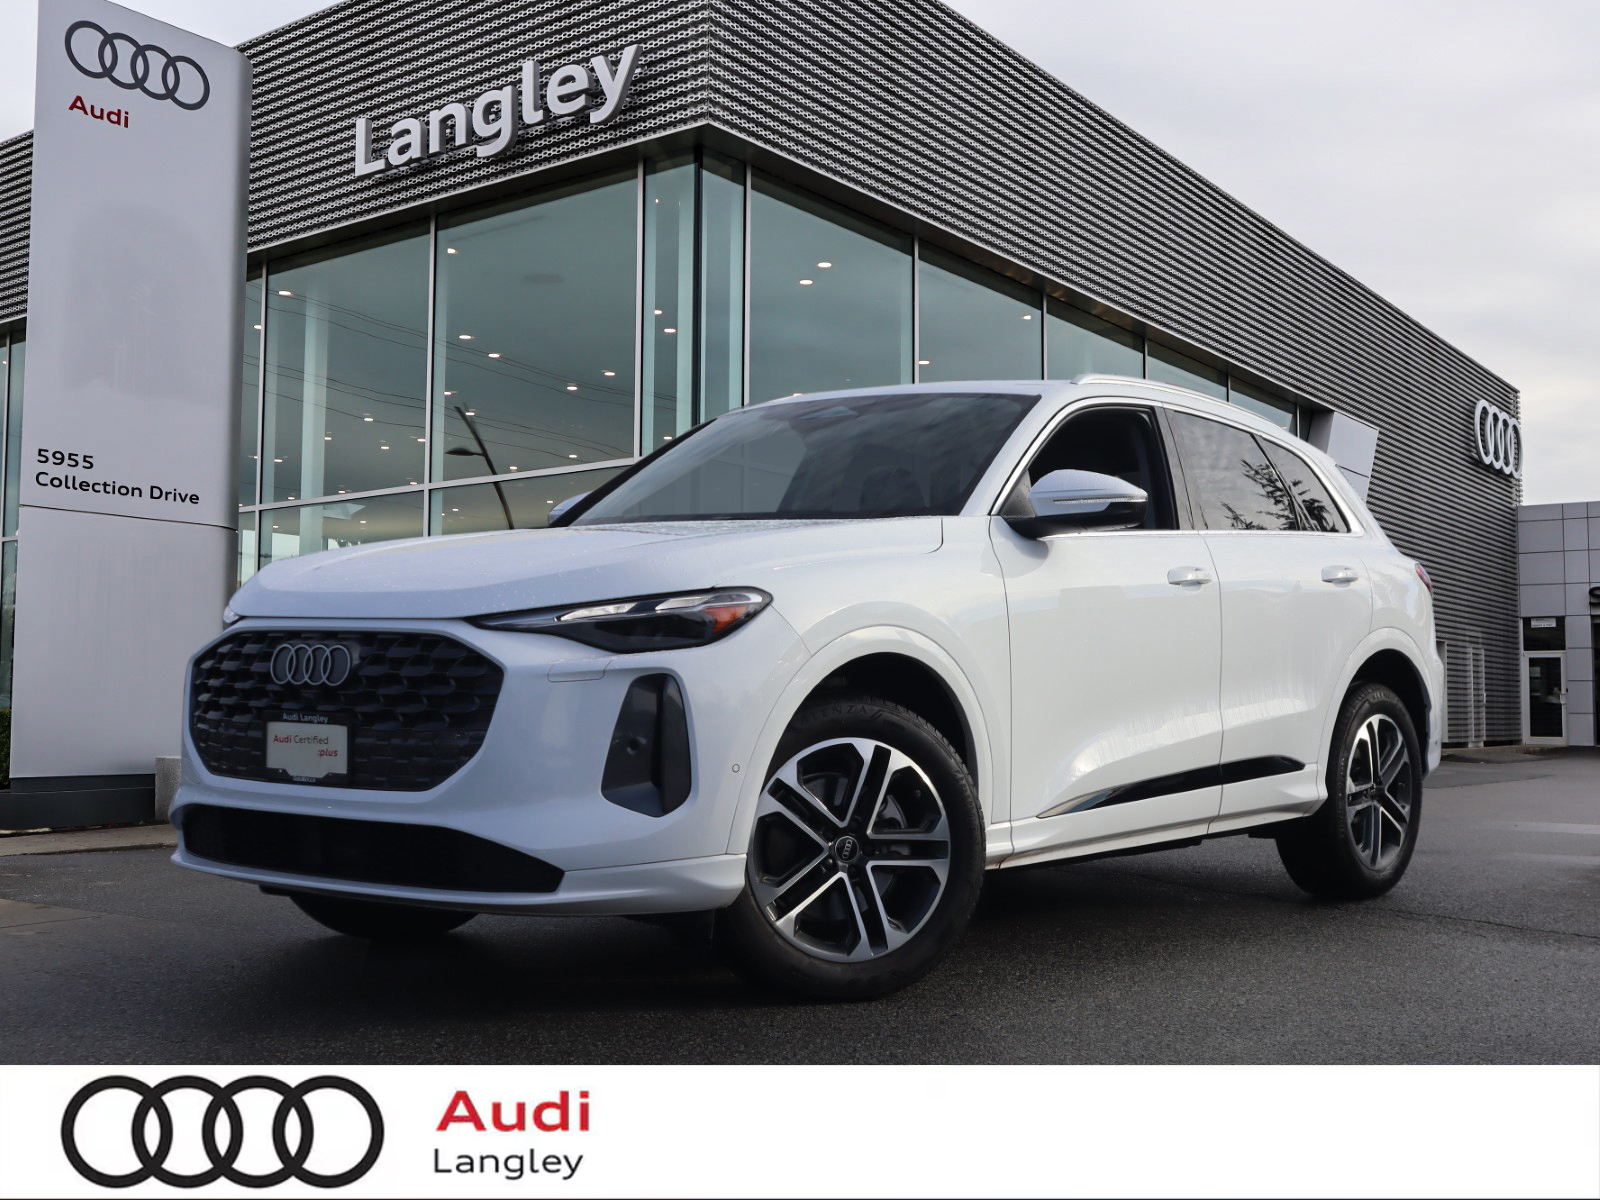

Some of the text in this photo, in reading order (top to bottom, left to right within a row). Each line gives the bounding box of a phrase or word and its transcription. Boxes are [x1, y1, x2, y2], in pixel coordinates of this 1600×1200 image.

[68, 95, 129, 128] Audi
[354, 43, 642, 177] Langley
[37, 448, 94, 469] 5955
[35, 471, 200, 504] Collection Drive
[282, 712, 329, 724] Audi Langley
[273, 734, 329, 745] Audi Certified
